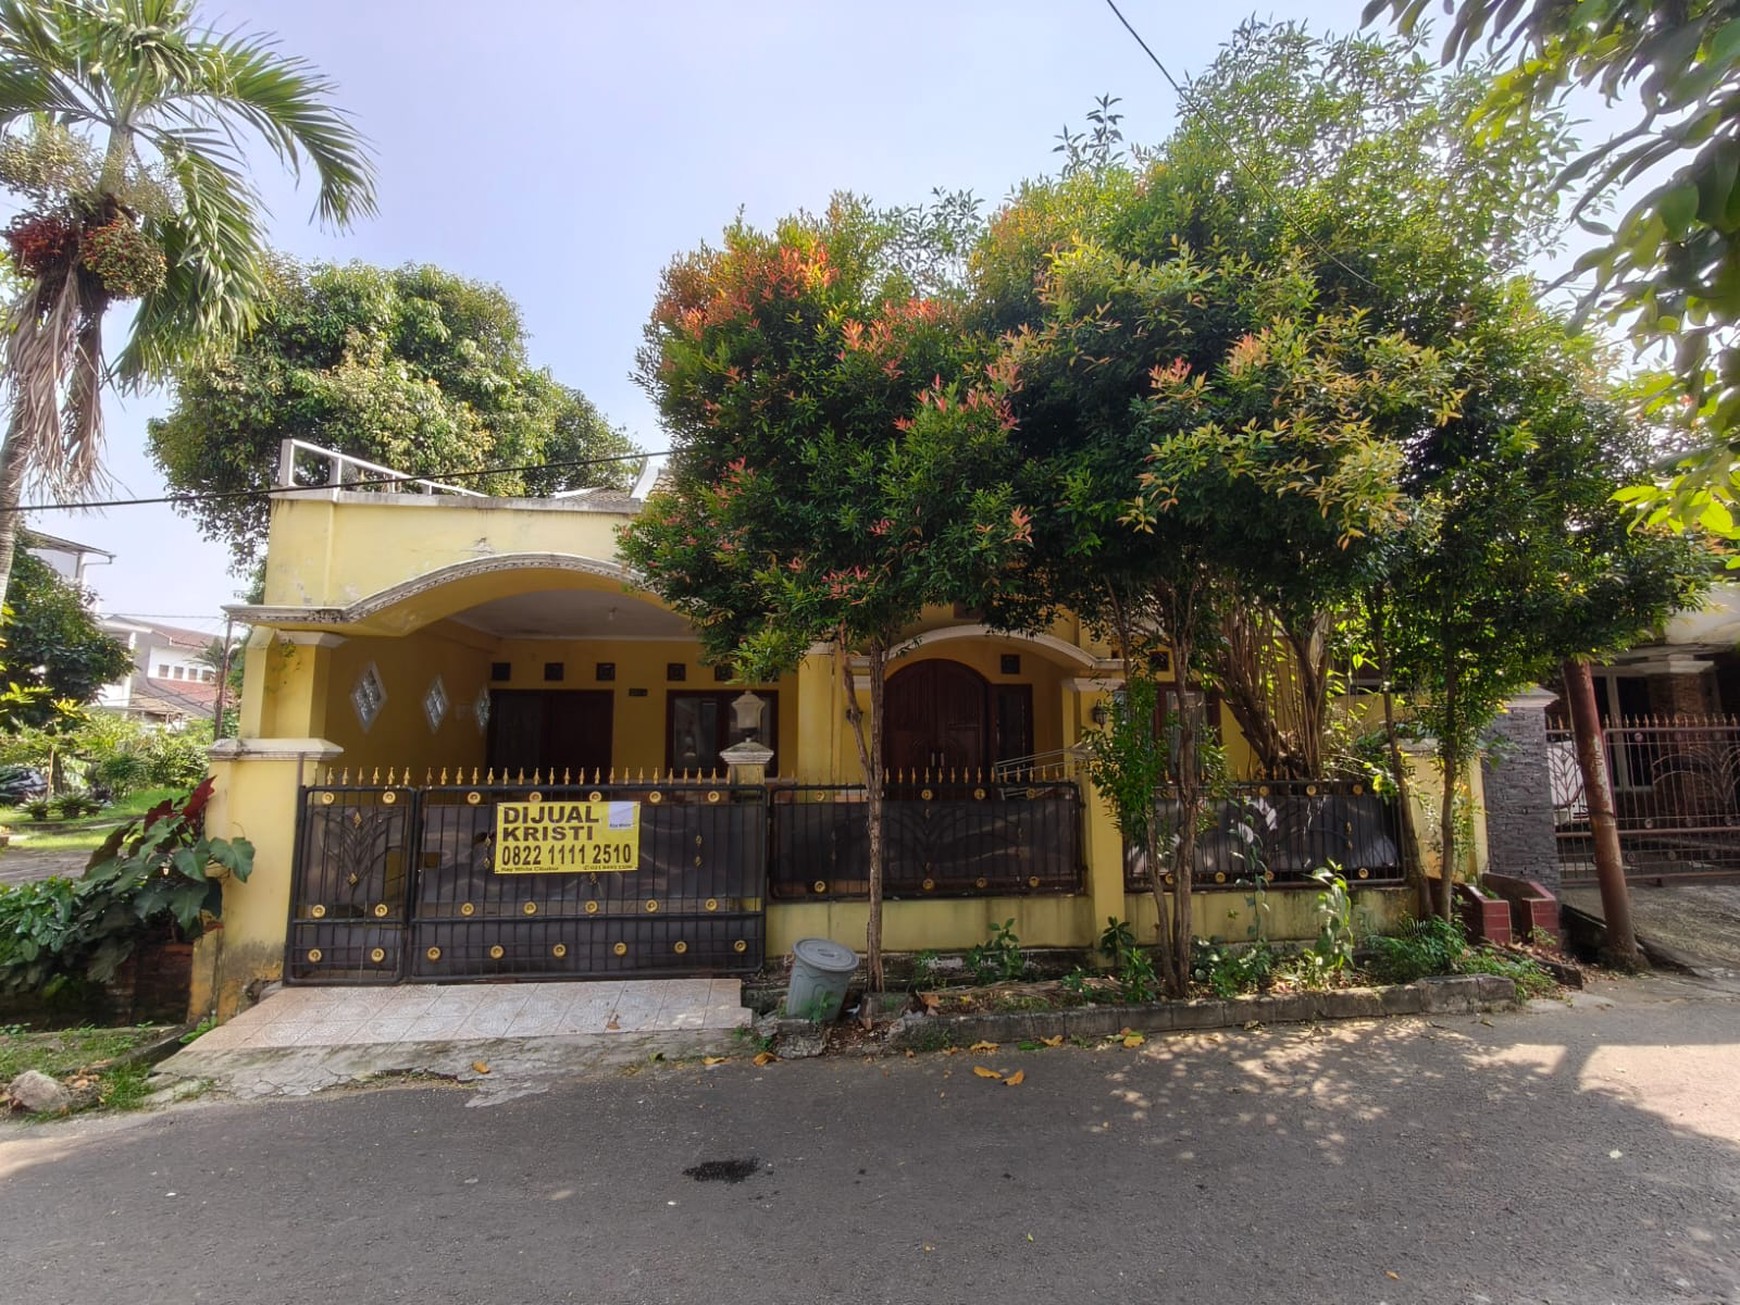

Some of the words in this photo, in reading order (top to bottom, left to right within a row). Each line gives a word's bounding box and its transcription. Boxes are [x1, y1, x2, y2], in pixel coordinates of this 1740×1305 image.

[503, 805, 600, 824] DIJUAL
[502, 826, 593, 842] KRISTI
[502, 845, 542, 866] 0822
[548, 844, 586, 865] 1111
[592, 843, 632, 864] 2510
